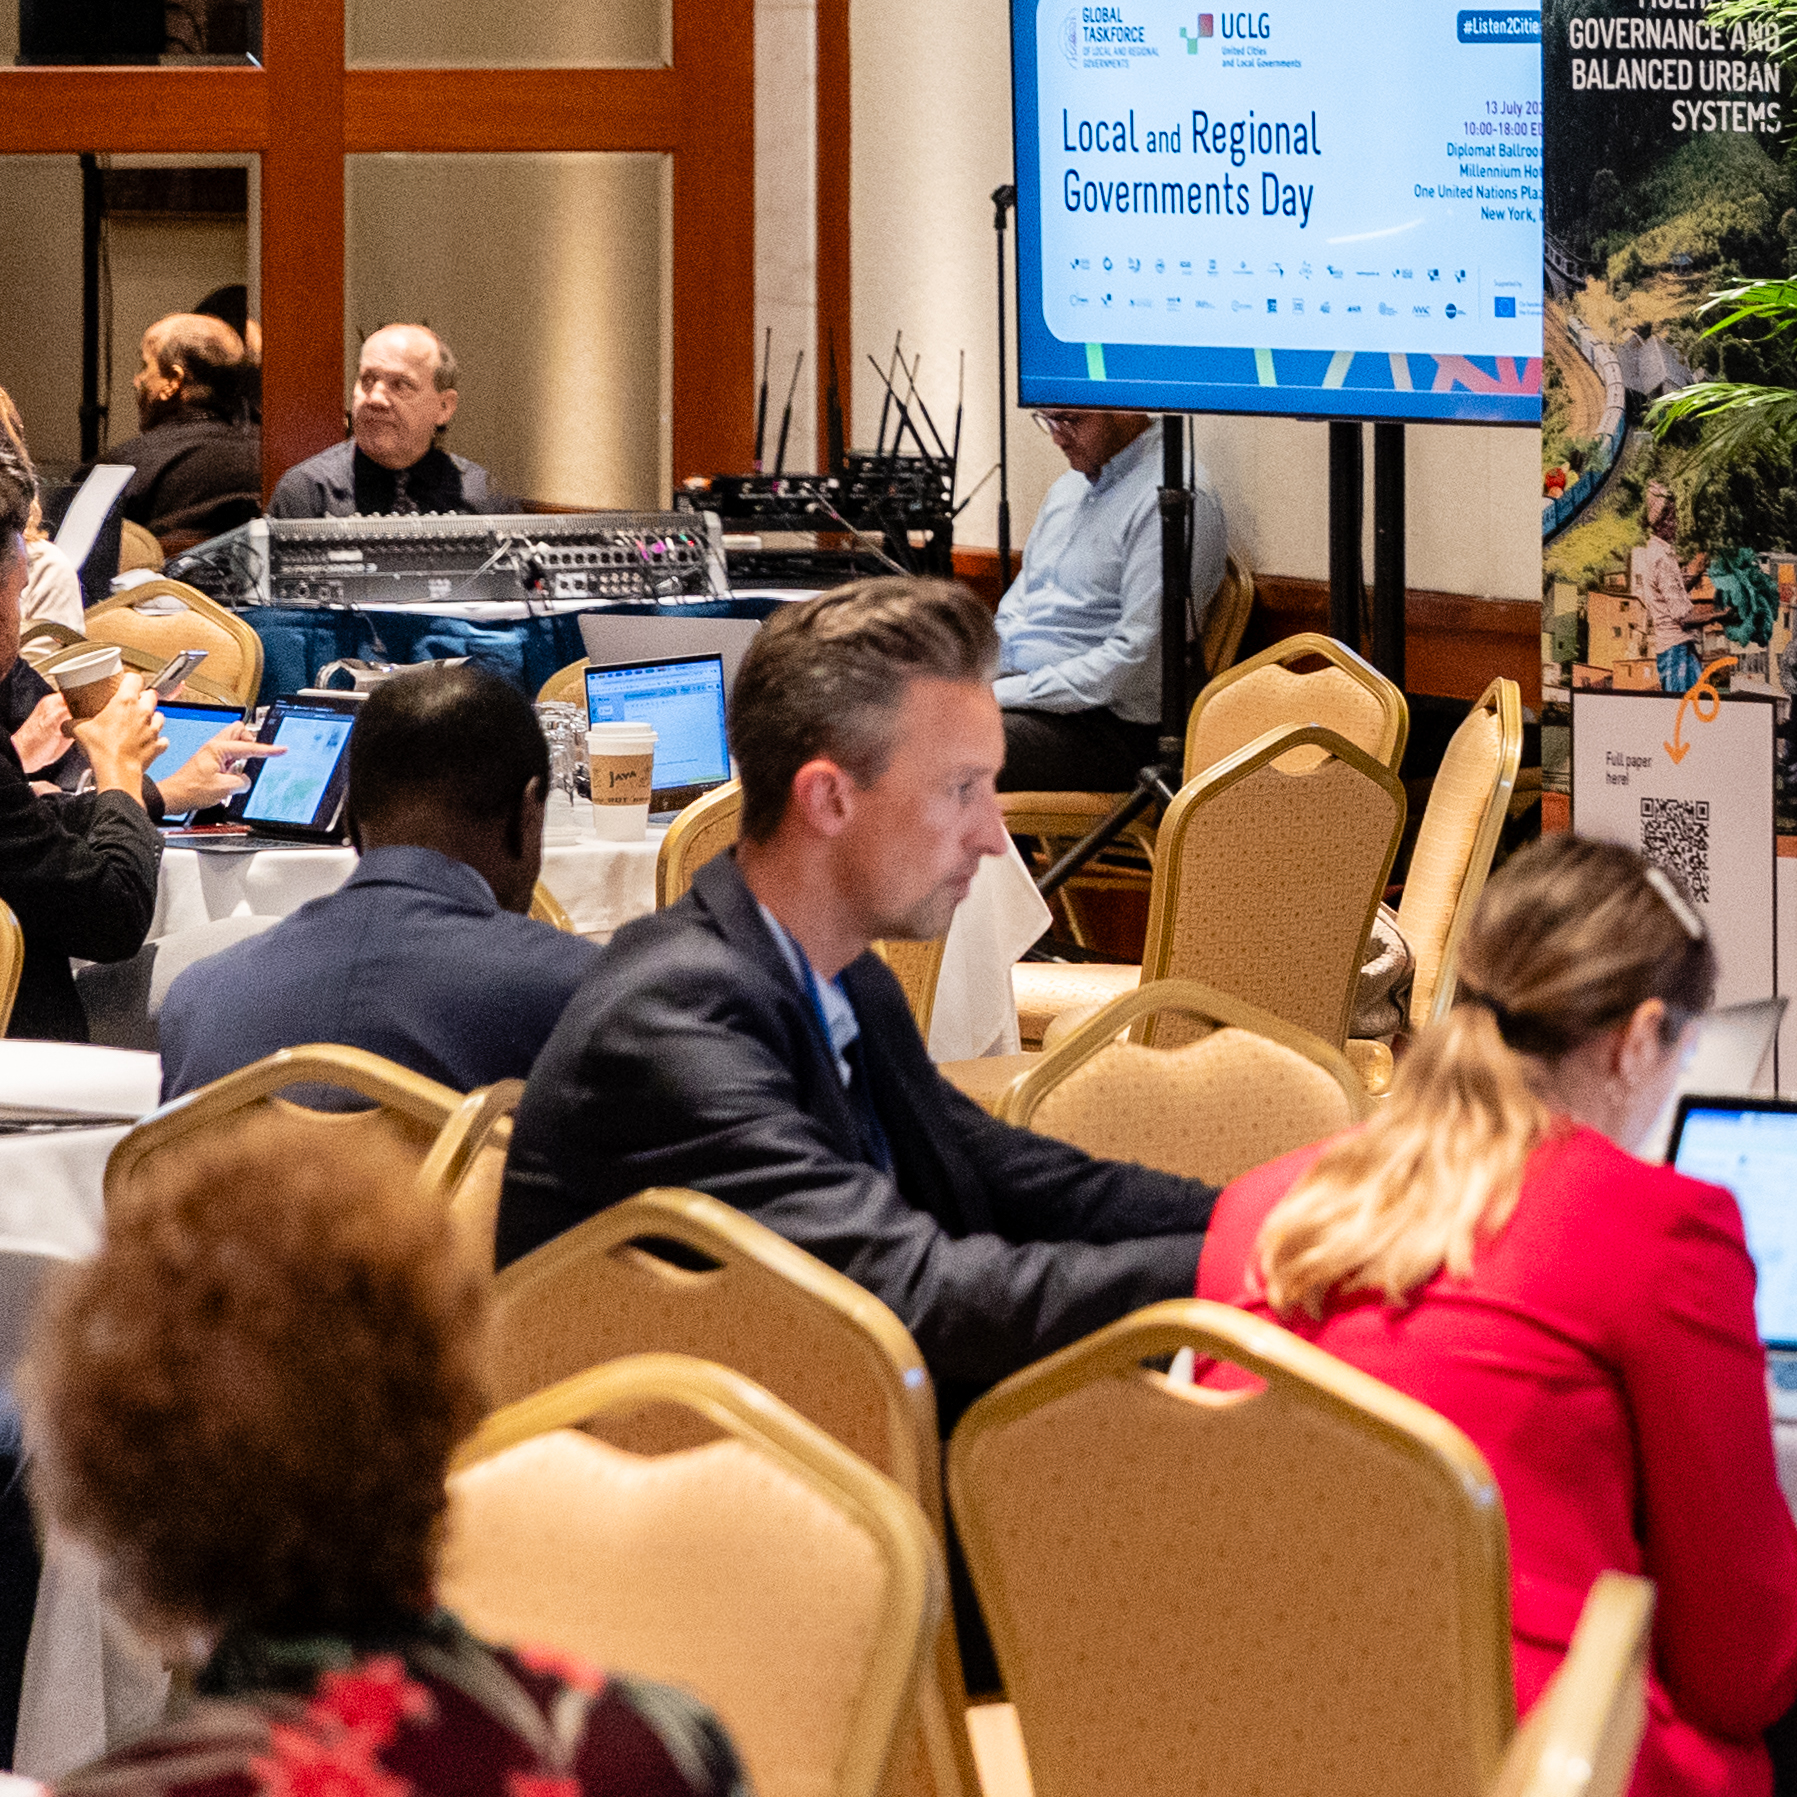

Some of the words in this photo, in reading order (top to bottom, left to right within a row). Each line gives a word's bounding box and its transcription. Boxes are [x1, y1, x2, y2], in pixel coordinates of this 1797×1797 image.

[1082, 7, 1123, 23] GLOBAL
[1083, 26, 1145, 43] TASKFORCE
[1221, 13, 1270, 39] UCLG
[1569, 17, 1725, 51] GOVERNANCE
[1730, 20, 1780, 52] AND
[1572, 58, 1693, 90] BALANCED
[1699, 59, 1780, 93] URBAN
[1485, 101, 1498, 114] 13
[1500, 101, 1523, 118] July
[1671, 99, 1782, 133] SYSTEMS
[1063, 108, 1139, 153] Local
[1146, 122, 1181, 153] and
[1192, 109, 1322, 167] Regional
[1464, 122, 1528, 136] 10:00-18:00
[1446, 142, 1496, 159] Diplomat
[1499, 143, 1543, 157] Ballroo
[1459, 163, 1521, 178] Millennium
[1063, 169, 1250, 216] Governments
[1261, 170, 1314, 229] Day
[1414, 184, 1435, 198] One
[1438, 185, 1473, 199] United
[1476, 185, 1517, 200] Nations
[1481, 207, 1505, 221] New
[1508, 207, 1536, 223] York,
